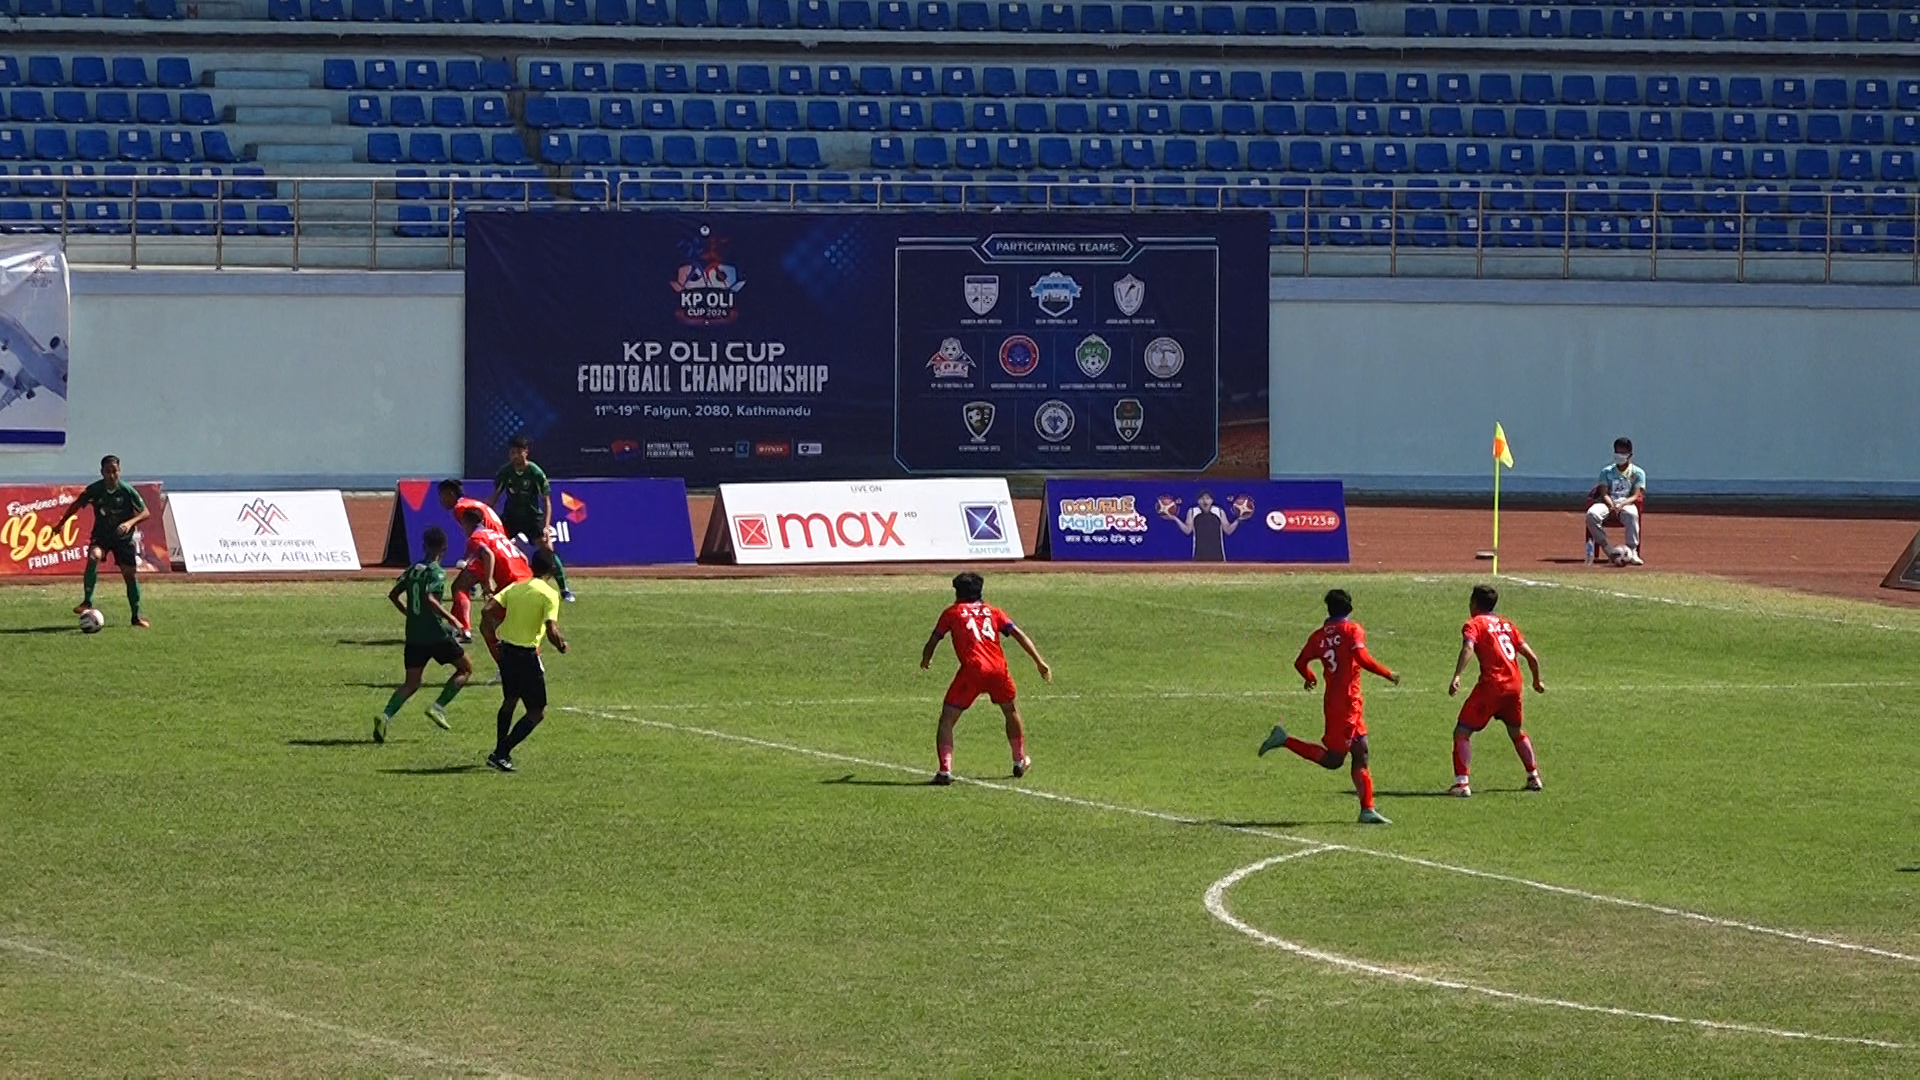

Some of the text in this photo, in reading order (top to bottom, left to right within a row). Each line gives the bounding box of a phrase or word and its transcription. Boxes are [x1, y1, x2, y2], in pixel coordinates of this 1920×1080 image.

[996, 243, 1119, 252] PARTICIPATING TEAMS:
[680, 292, 734, 307] KP OLI
[687, 308, 705, 317] CUP
[623, 341, 786, 362] KP OLI CUP
[578, 364, 829, 392] FOOTBALL CHAMPIONSHIP
[643, 405, 692, 420] Falgun,
[695, 405, 734, 418] 2080,
[736, 405, 812, 417] Kathmandu
[850, 485, 882, 493] LIVE ON
[6, 498, 57, 517] Experience
[1062, 498, 1134, 514] DOUBLE
[0, 511, 80, 562] Best
[776, 511, 918, 549] max HD
[28, 554, 59, 570] FROM
[62, 548, 81, 563] THE
[193, 550, 351, 564] HIMALAYA AIRLINES
[966, 617, 995, 643] 14
[1498, 633, 1515, 660] 6
[1323, 649, 1338, 673] 3
